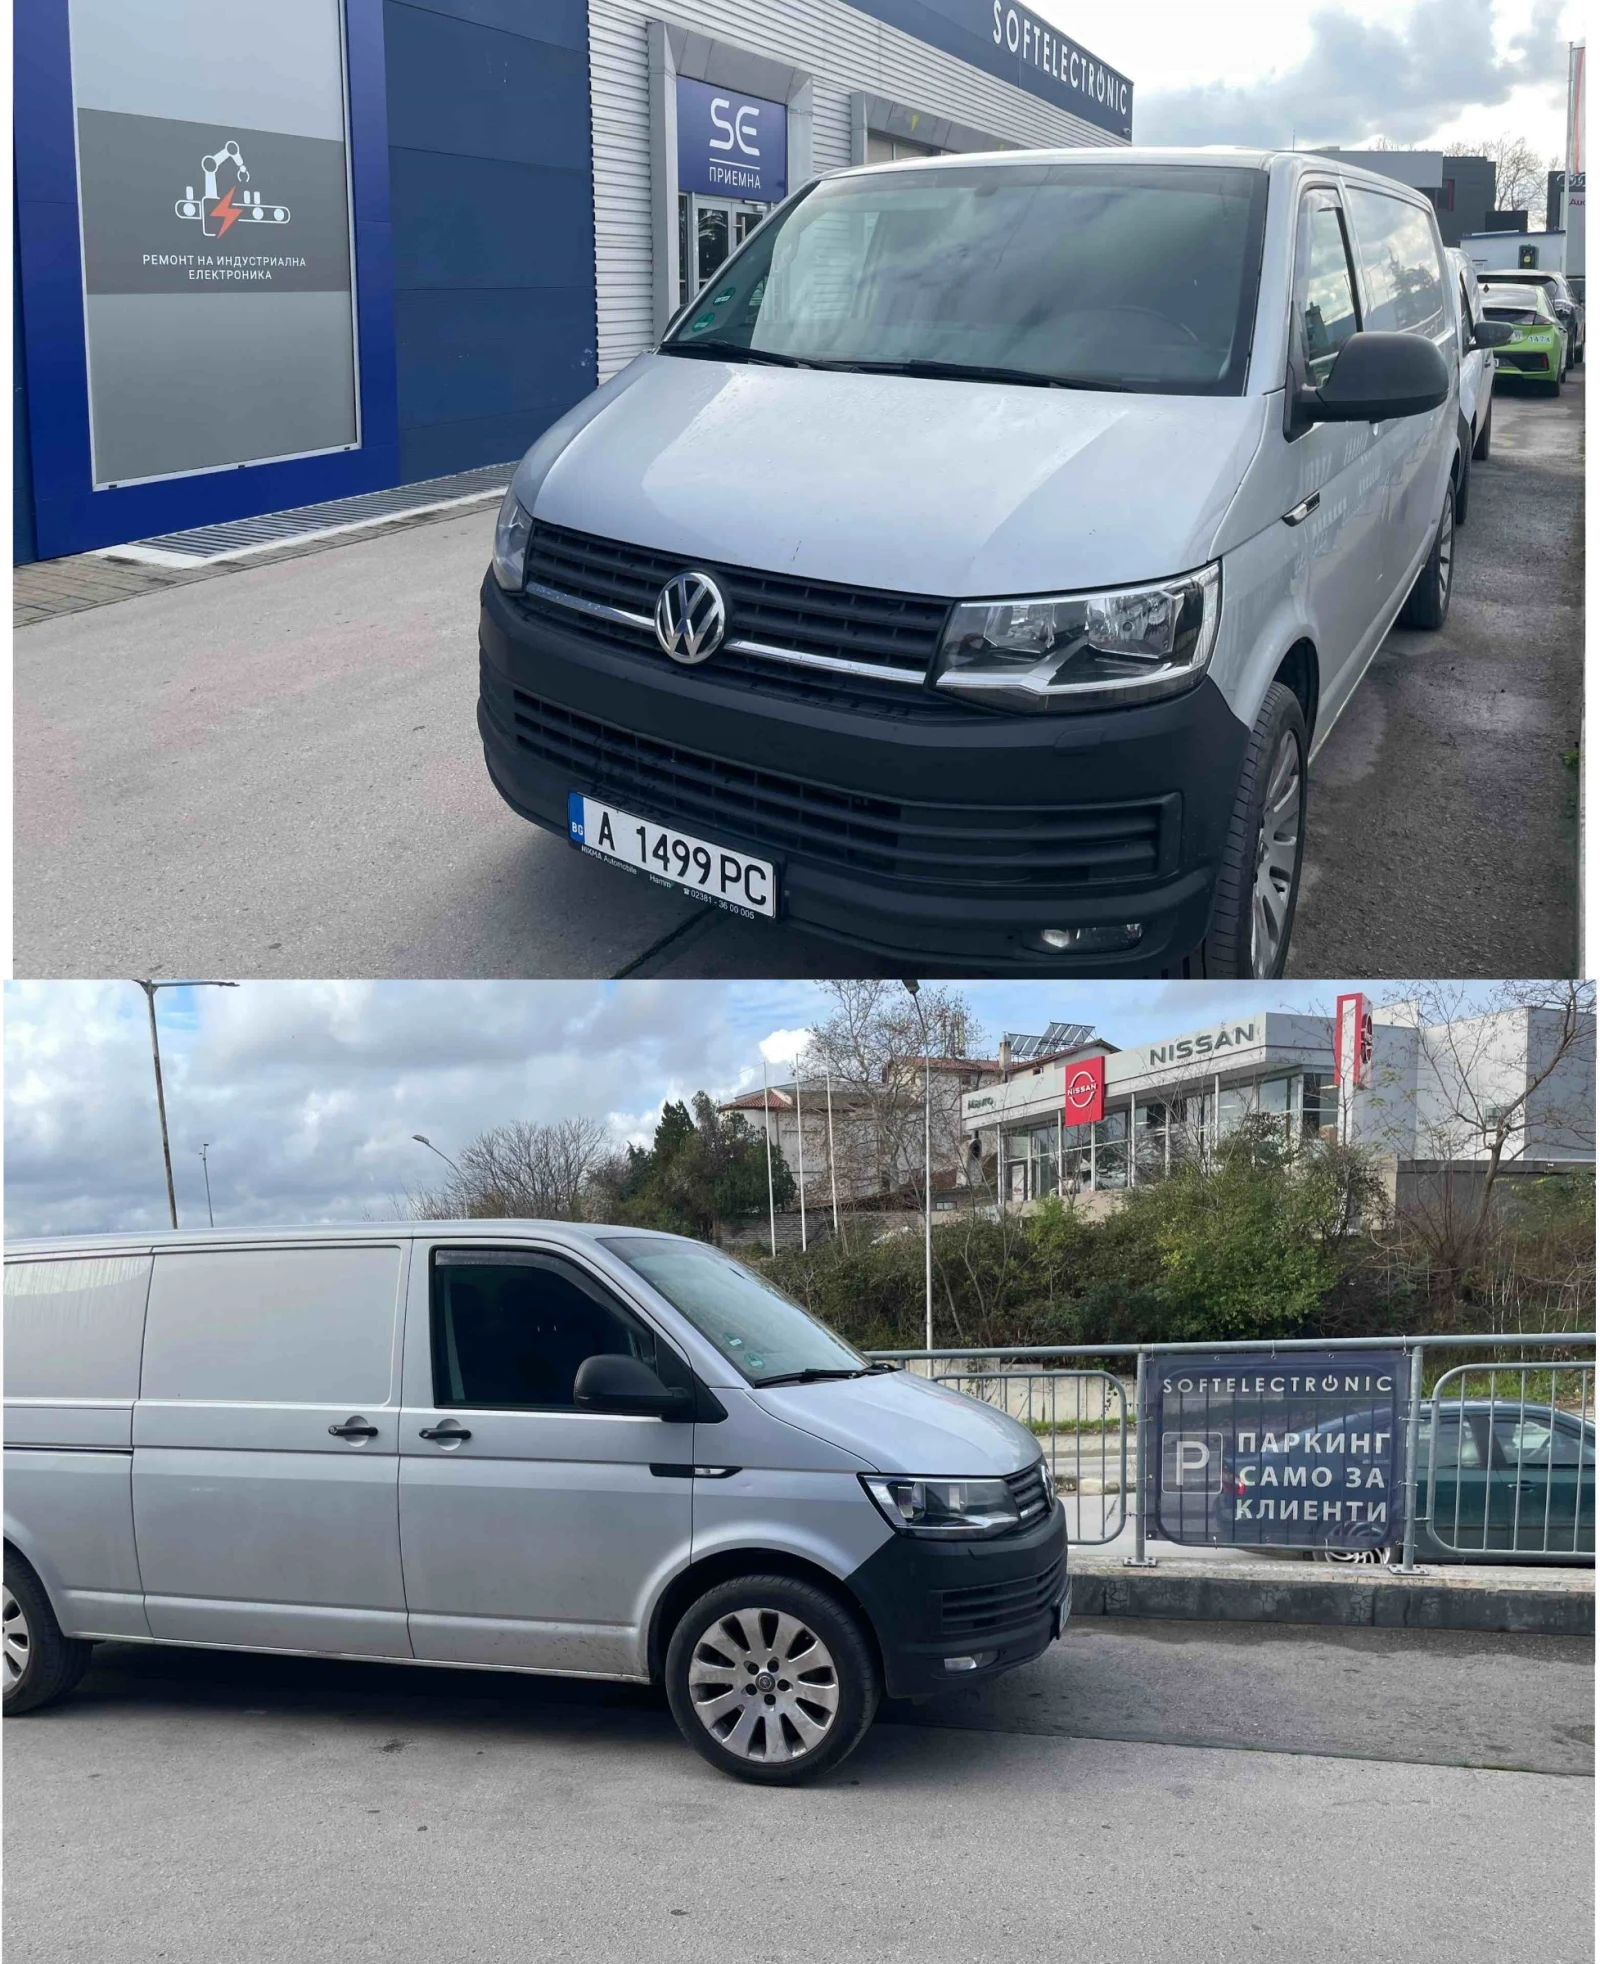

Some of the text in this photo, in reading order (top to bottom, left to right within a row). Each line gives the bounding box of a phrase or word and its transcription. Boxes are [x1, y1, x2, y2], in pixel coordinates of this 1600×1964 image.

[993, 0, 1127, 115] SOFTELECTRONIC
[709, 166, 760, 189] ПРИЕМНА
[142, 254, 306, 268] РЕМОНТ НА ИНДУСТРИАЛНА
[188, 269, 272, 280] ЕЛЕКТРОНИКА
[571, 821, 584, 836] BG
[603, 855, 637, 875] Automobile
[690, 889, 712, 904] 02381
[740, 908, 755, 919] 005
[1150, 1023, 1254, 1066] NISSAN
[1067, 1083, 1097, 1096] NISSAN
[1163, 1375, 1393, 1393] SOFTELECTRONIC
[1238, 1432, 1390, 1454] ПАРКИНГ
[1175, 1440, 1210, 1486] P
[1239, 1465, 1385, 1489] САМО ЗА
[1235, 1499, 1387, 1523] КЛИЕНТИ
